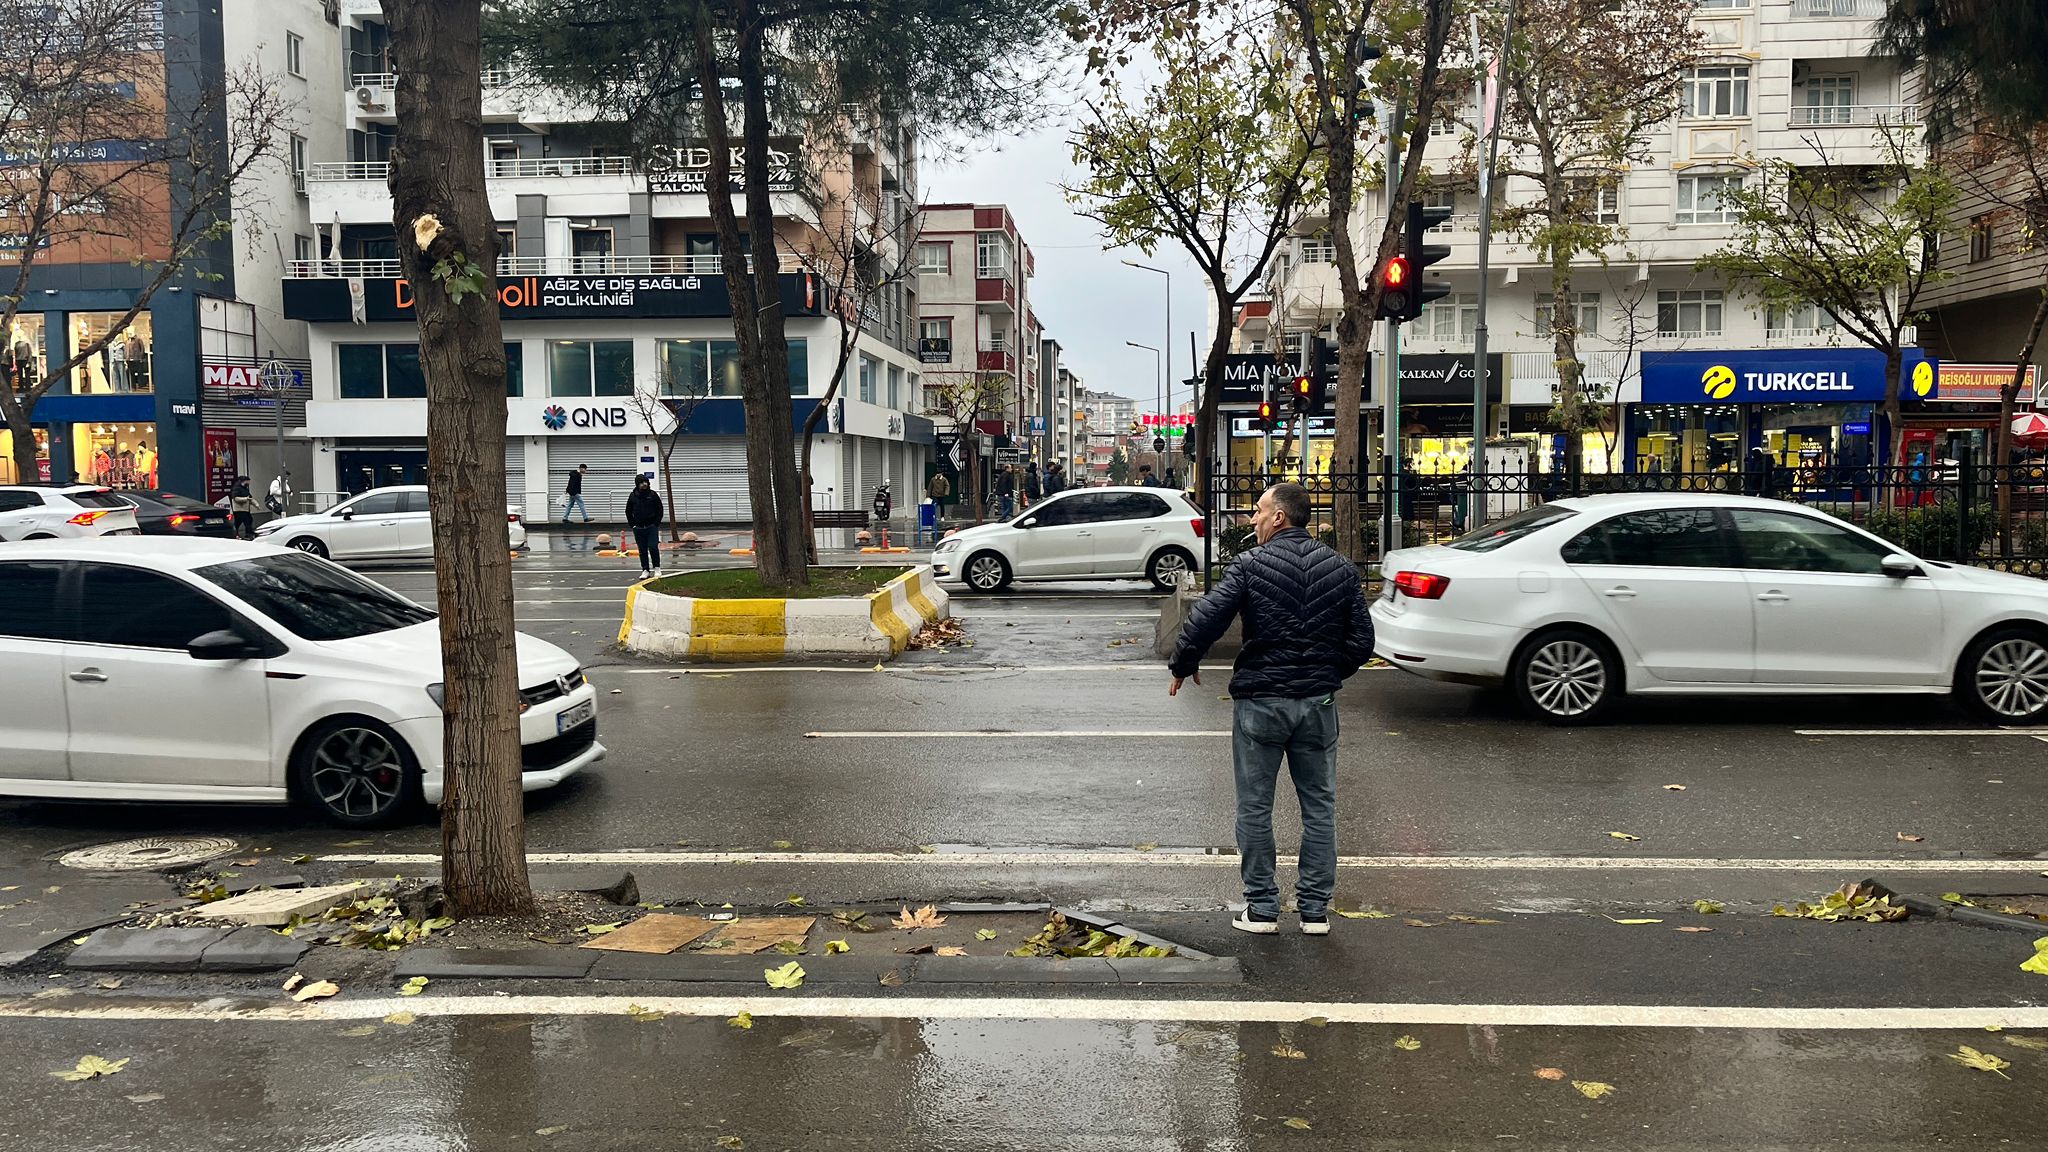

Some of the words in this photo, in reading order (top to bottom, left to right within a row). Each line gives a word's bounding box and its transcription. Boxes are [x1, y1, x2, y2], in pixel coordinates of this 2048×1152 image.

[543, 278, 578, 291] AĞIZ
[584, 279, 605, 290] VE
[609, 277, 635, 294] DİŞ
[639, 276, 701, 291] SAĞLIĞI
[543, 290, 634, 306] POLİKLİNİĞİ
[1399, 369, 1445, 379] KALKAN
[1459, 369, 1491, 379] GOD
[1743, 372, 1854, 391] TURKCELL
[1939, 371, 1982, 386] REİSOĞLU
[173, 403, 196, 415] mavi
[572, 407, 627, 428] QNB
